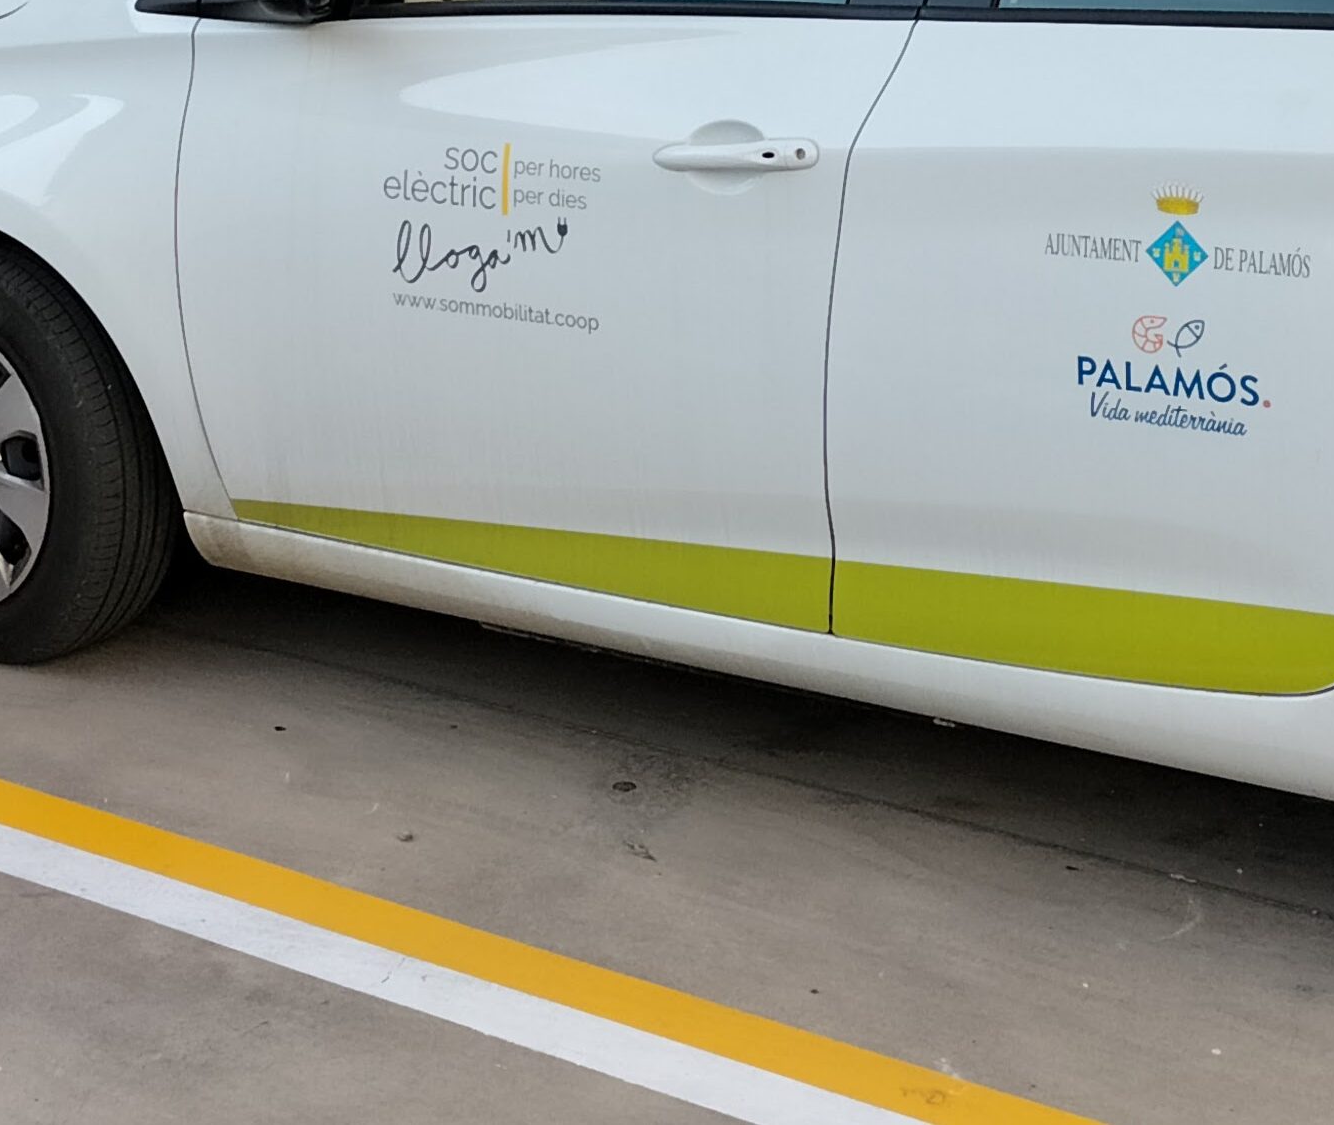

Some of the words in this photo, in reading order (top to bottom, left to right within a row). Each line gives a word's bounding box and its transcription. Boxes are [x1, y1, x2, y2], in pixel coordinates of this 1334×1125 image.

[514, 159, 544, 179] per
[549, 159, 601, 182] hores
[383, 169, 497, 210] elèctric
[514, 188, 544, 207] per
[548, 189, 587, 210] dies
[1044, 233, 1142, 263] AJUNTAMENT
[1213, 246, 1234, 271] DE
[1238, 247, 1311, 278] PALAMÓS
[392, 292, 600, 334] www.sommobilitat.coop
[1089, 391, 1131, 422] Vida
[1134, 404, 1248, 436] mediterrània
